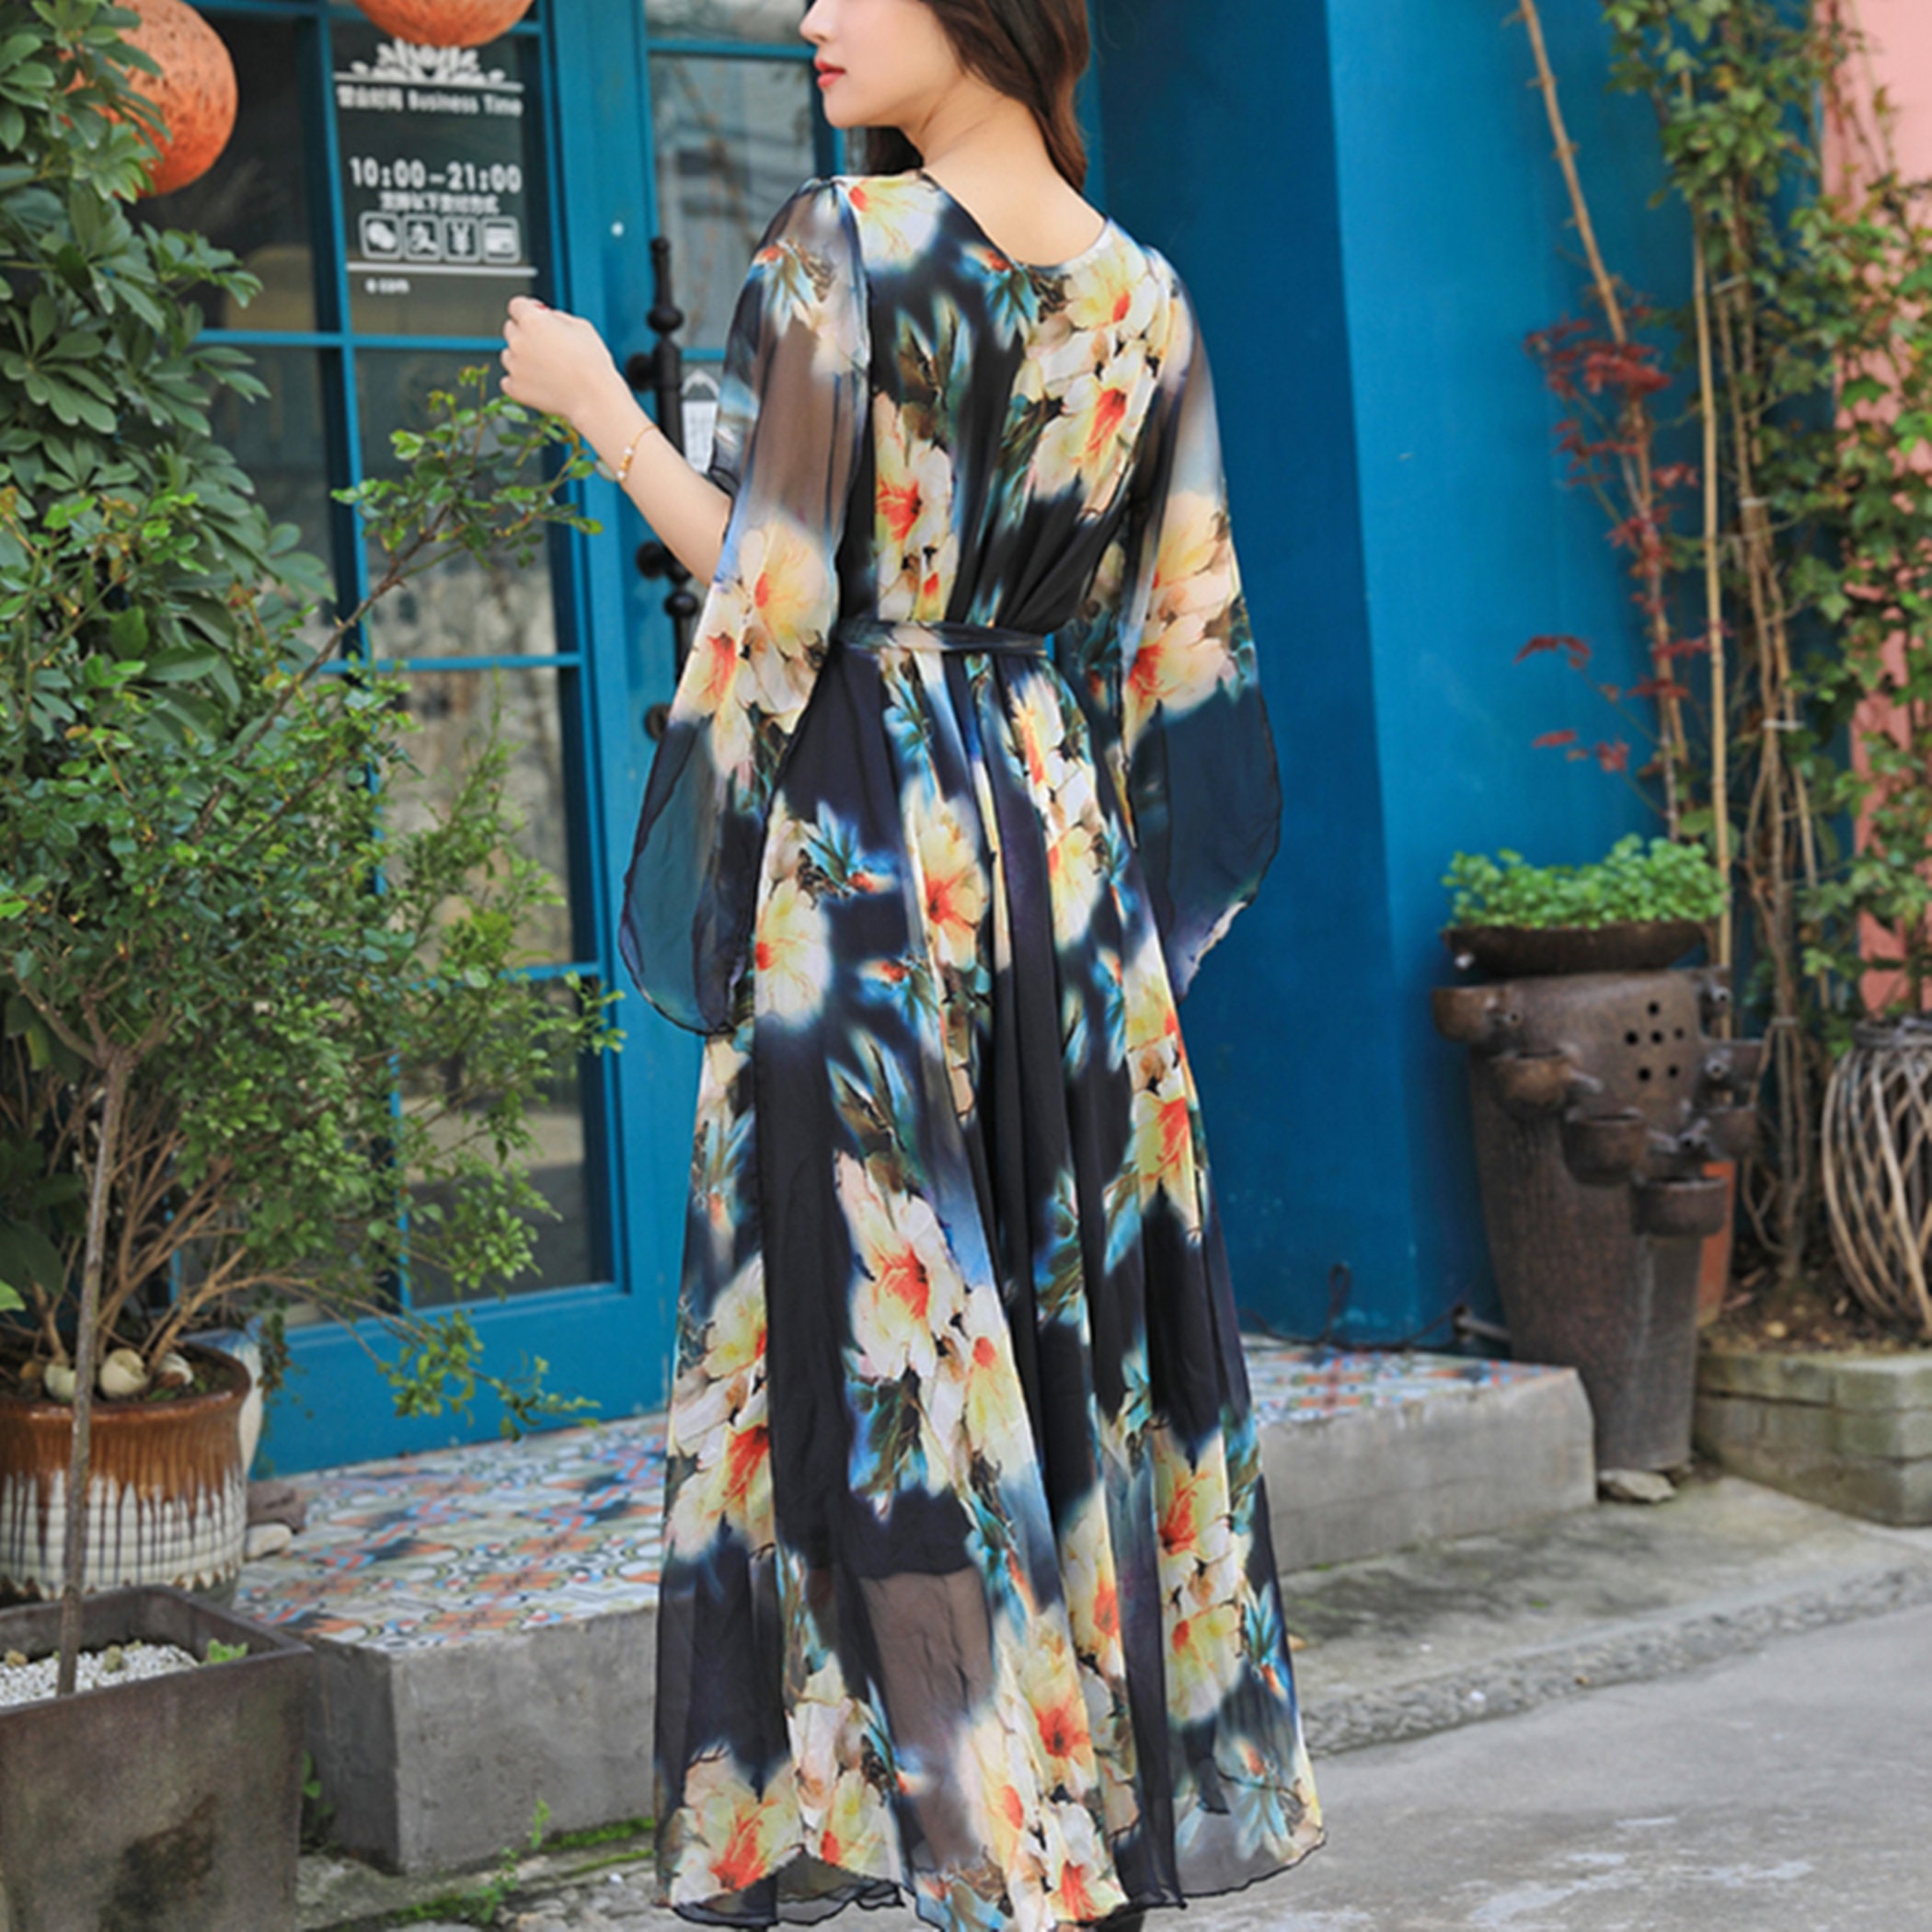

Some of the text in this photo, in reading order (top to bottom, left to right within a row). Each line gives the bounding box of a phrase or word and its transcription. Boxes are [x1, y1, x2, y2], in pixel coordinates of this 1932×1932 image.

[408, 89, 523, 117] Business Time
[350, 156, 522, 193] 10:00-21:00
